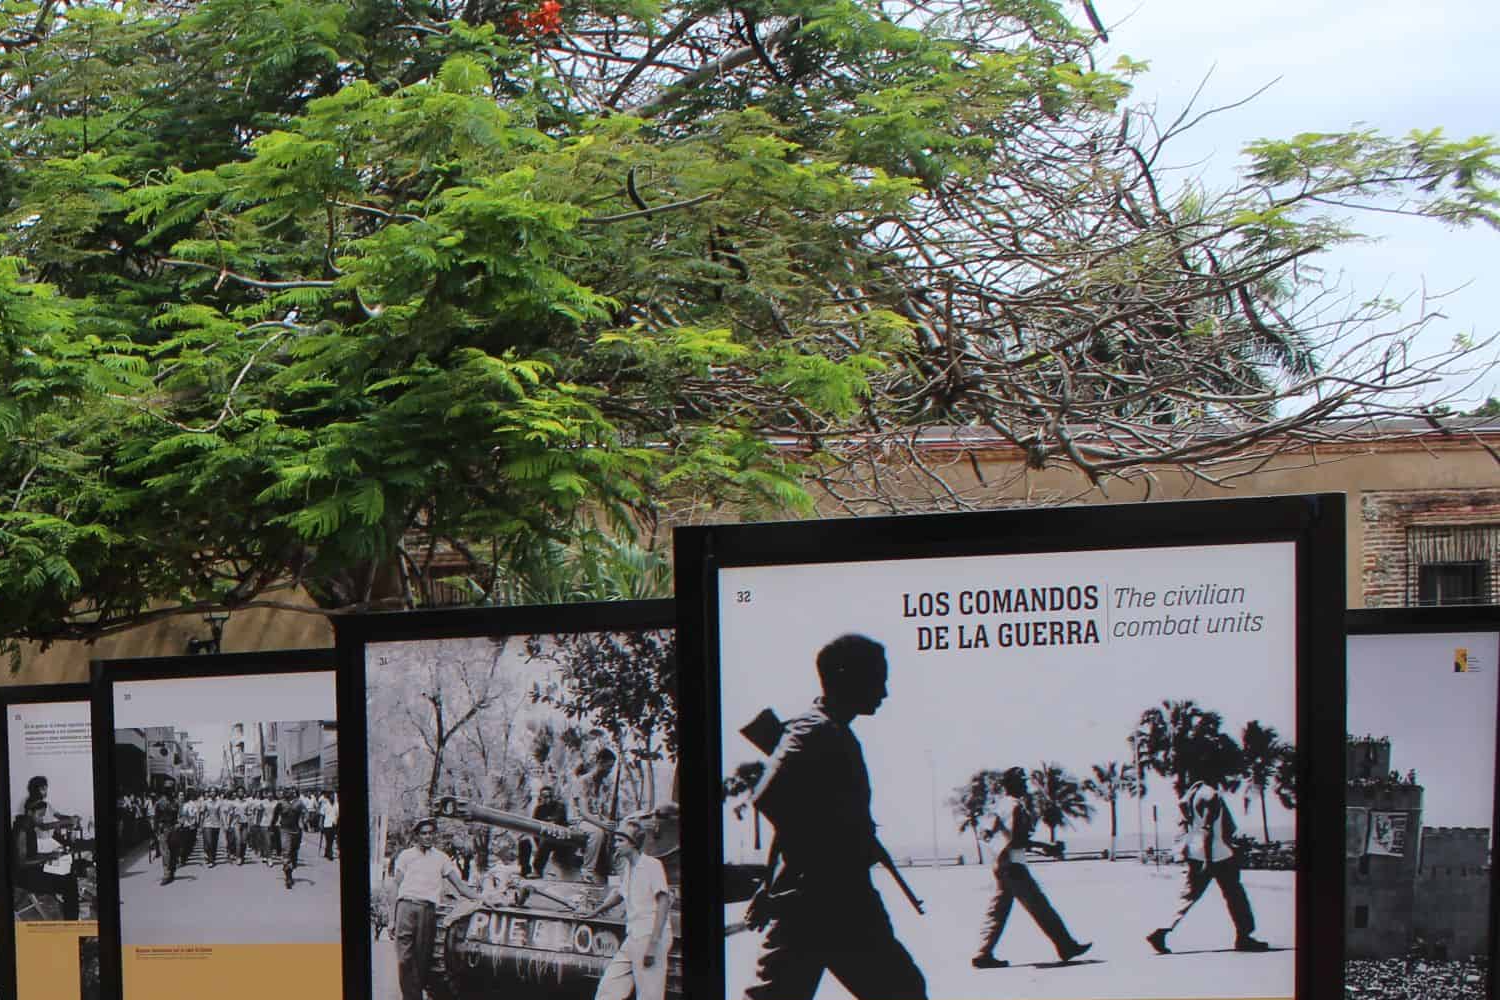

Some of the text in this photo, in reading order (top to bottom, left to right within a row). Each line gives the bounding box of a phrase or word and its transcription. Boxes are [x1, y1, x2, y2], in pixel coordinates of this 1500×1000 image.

[737, 591, 751, 602] 32
[902, 585, 1098, 618] LOS COMANDOS
[1114, 583, 1245, 608] The civilian
[917, 620, 1100, 650] DE LA GUERRA
[1113, 612, 1263, 637] combat units
